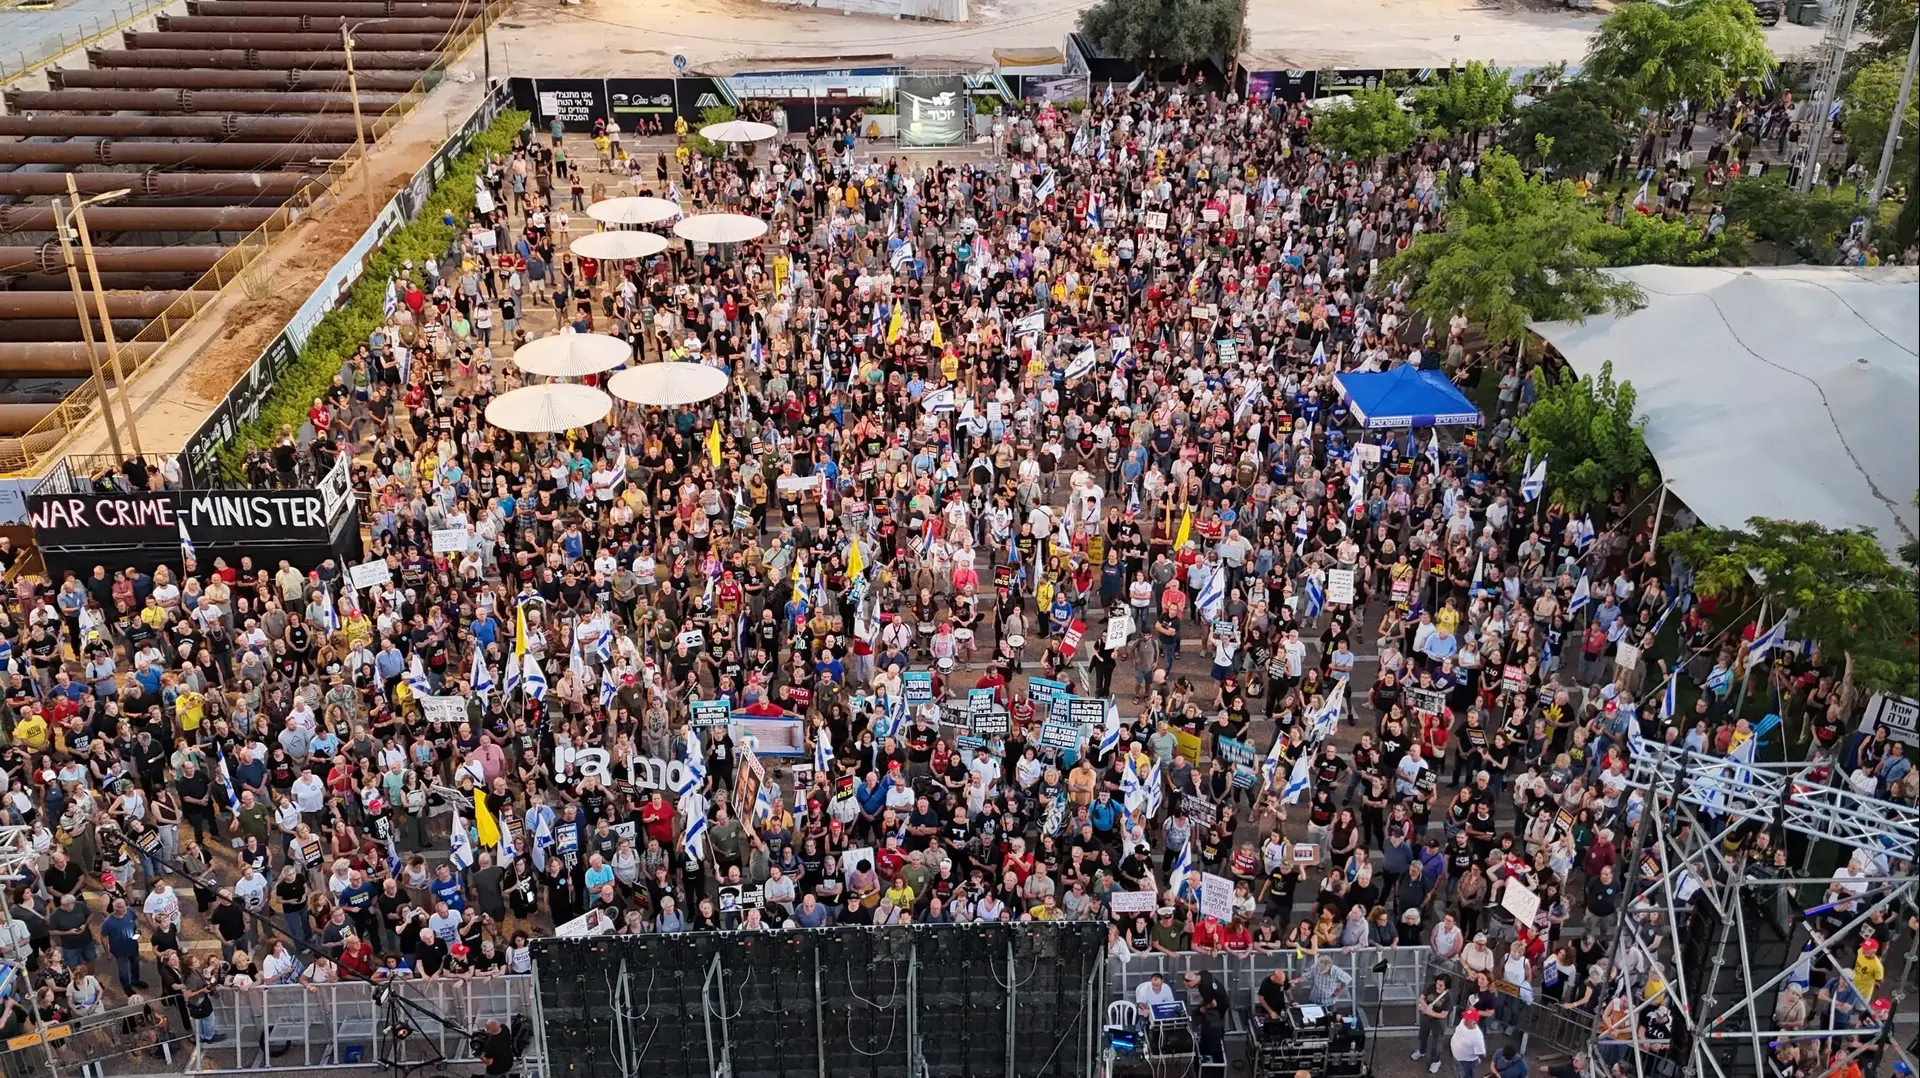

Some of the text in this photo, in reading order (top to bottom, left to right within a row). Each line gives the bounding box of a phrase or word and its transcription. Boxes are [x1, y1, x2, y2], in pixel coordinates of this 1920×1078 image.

[557, 91, 592, 99] אנו מתנצל
[928, 110, 956, 121] יזכור
[30, 499, 91, 529] WAR
[1891, 702, 1913, 716] אמא
[1887, 712, 1910, 726] ערה
[26, 724, 41, 736] NOW
[627, 754, 685, 792] סרבו
